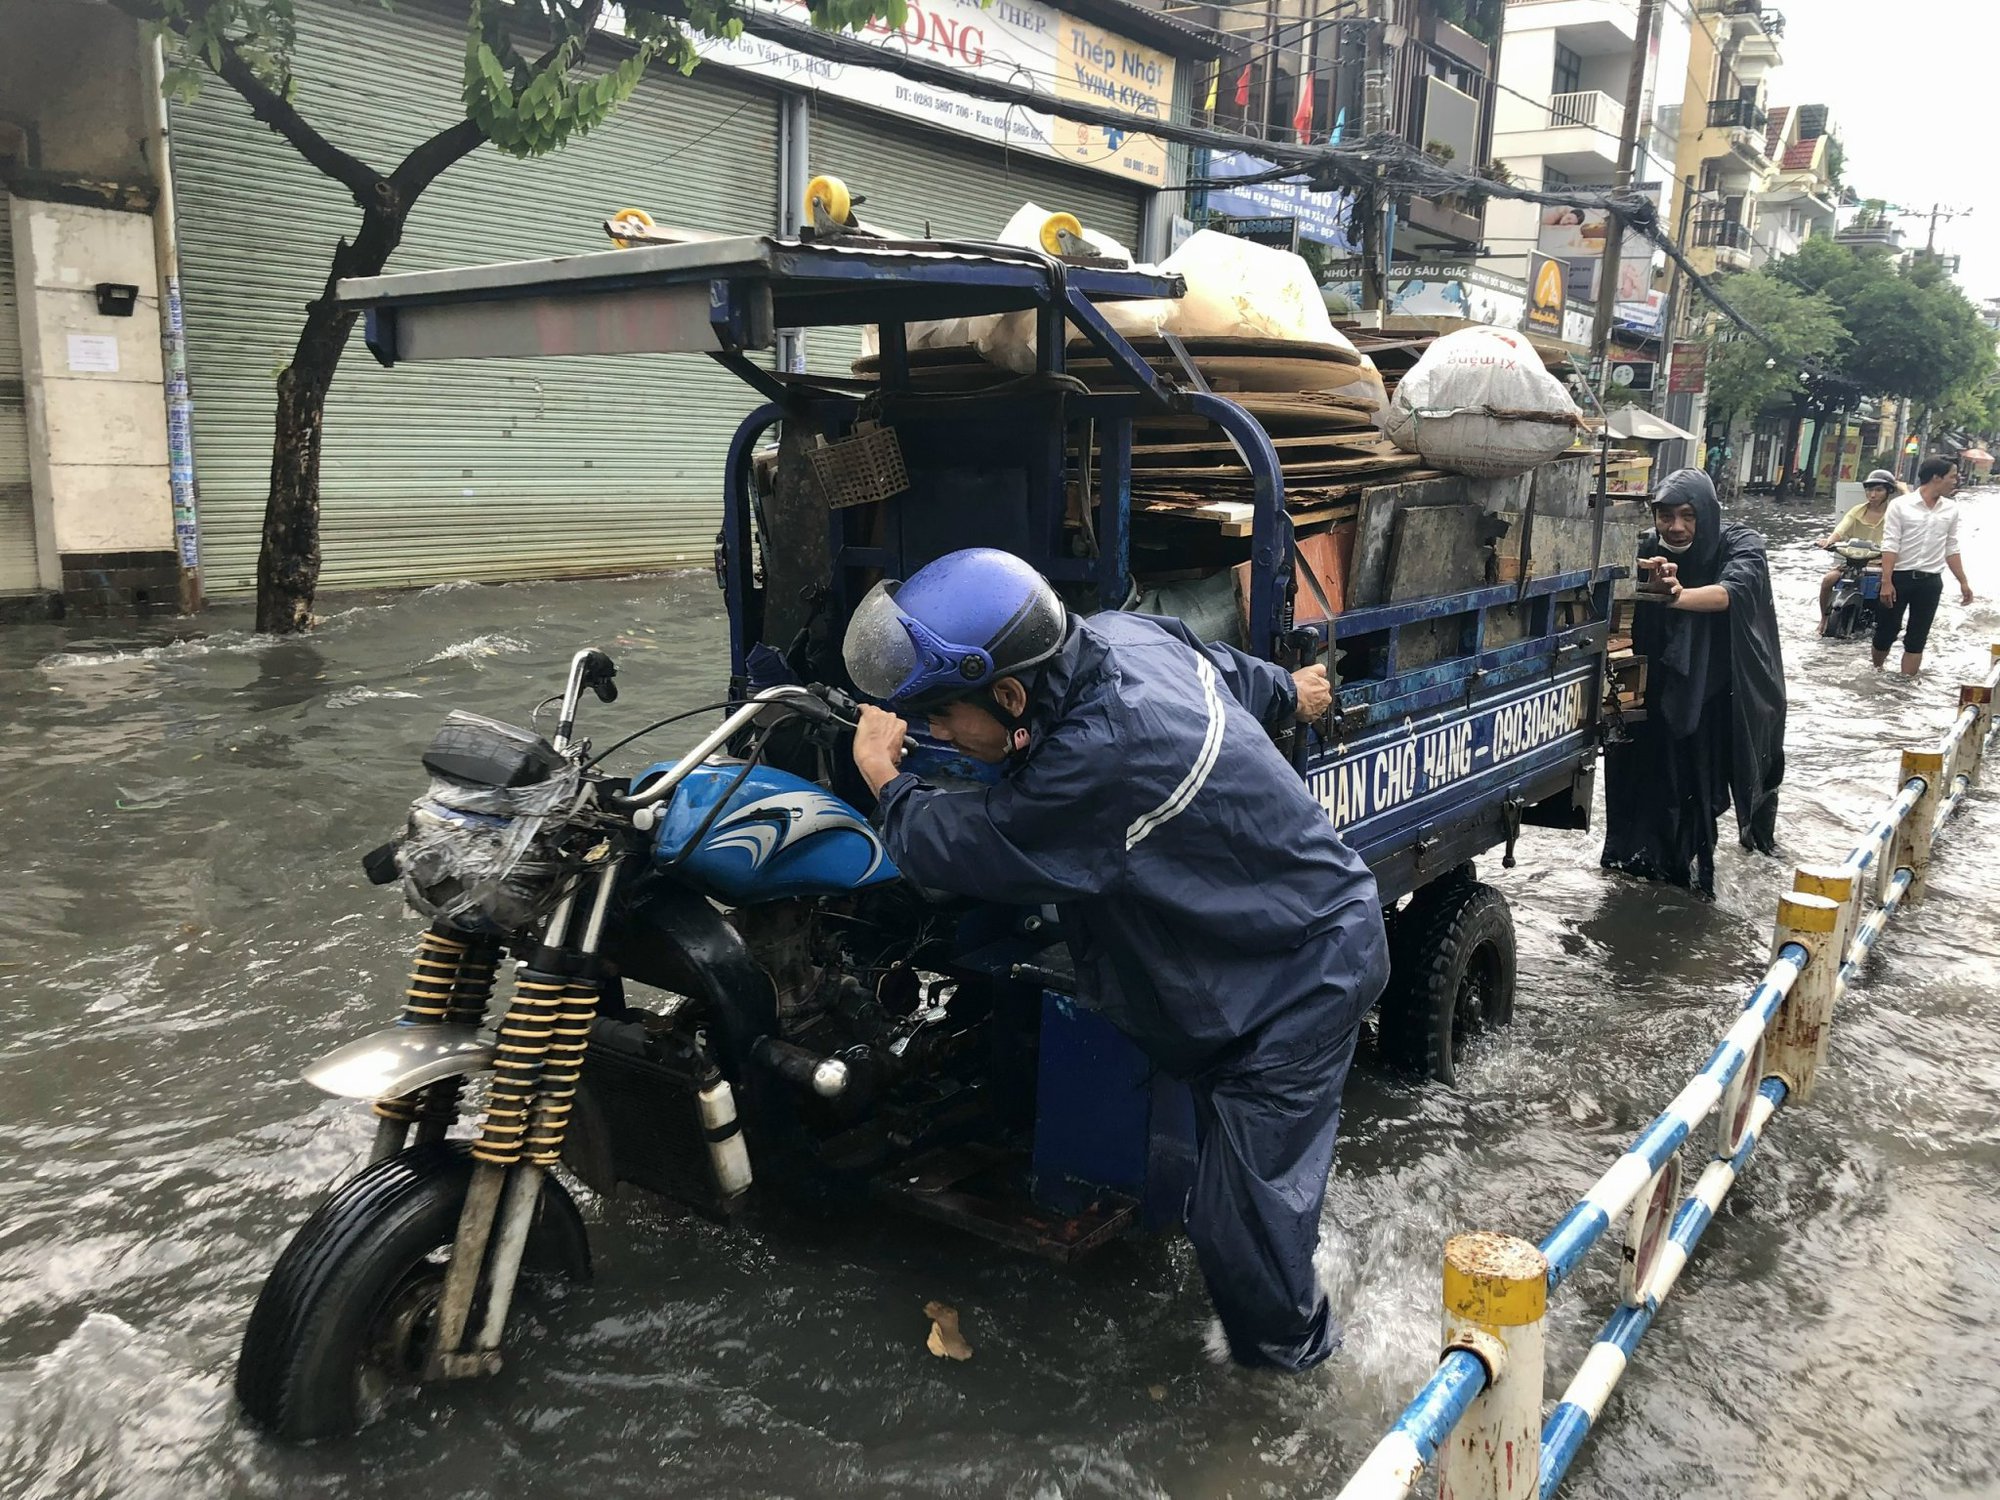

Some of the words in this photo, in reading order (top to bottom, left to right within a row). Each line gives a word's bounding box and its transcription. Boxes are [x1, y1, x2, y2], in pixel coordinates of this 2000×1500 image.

[1071, 28, 1116, 74] Thép
[1122, 49, 1164, 90] Nhật
[1414, 264, 1439, 277] SÂU
